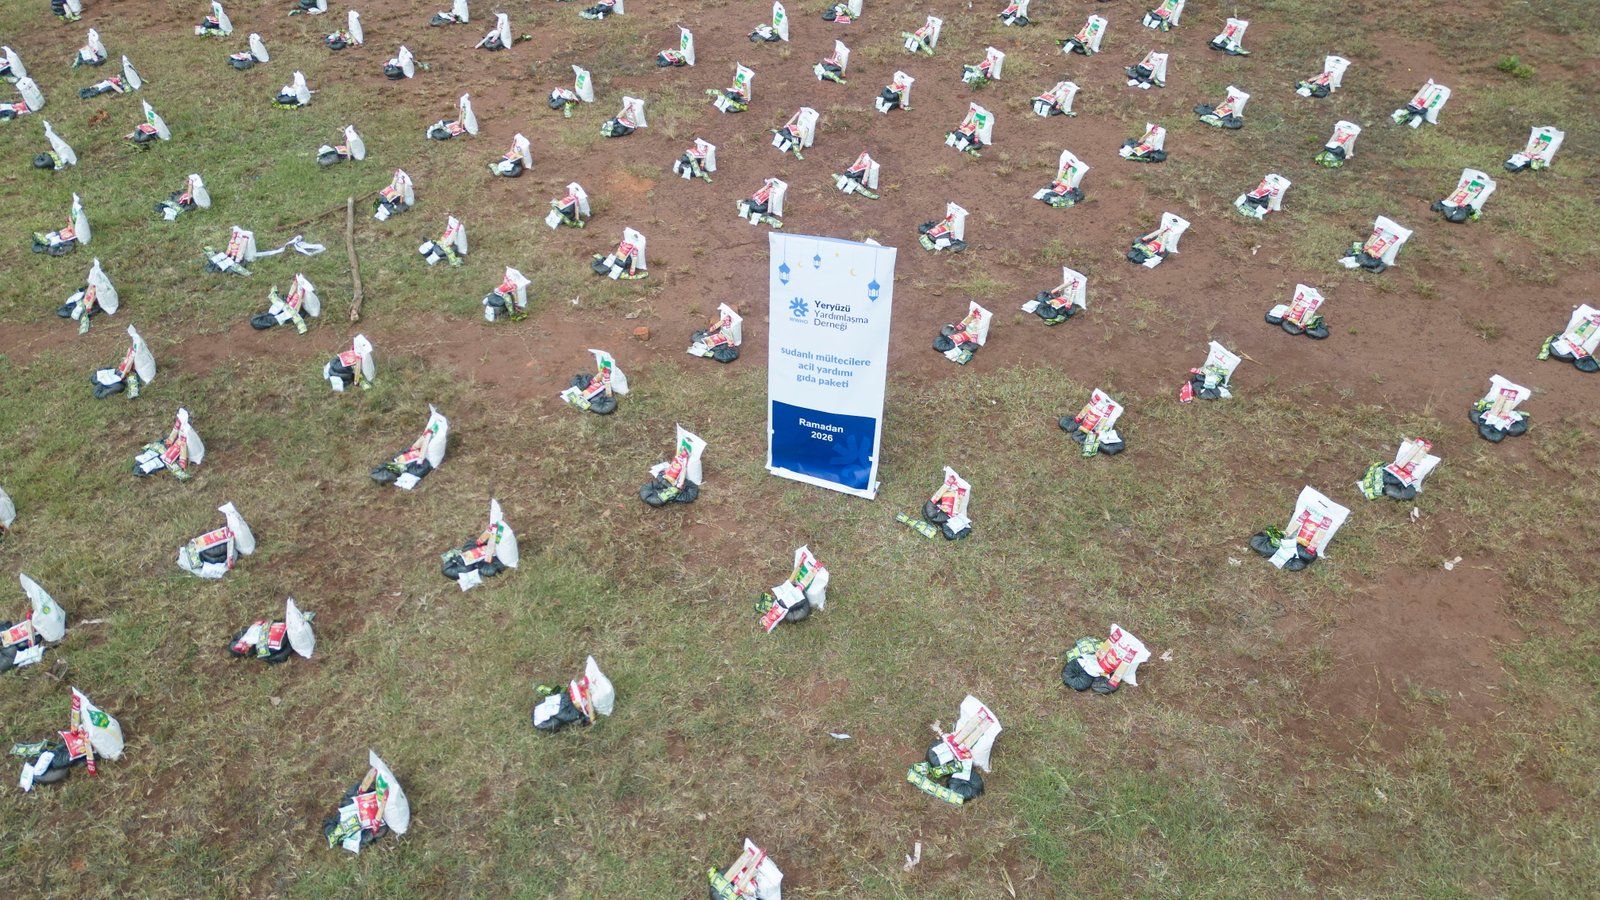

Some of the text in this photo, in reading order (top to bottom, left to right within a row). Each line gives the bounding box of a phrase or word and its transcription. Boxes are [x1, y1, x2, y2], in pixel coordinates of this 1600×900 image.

[814, 300, 851, 312] Yeryüzü
[814, 310, 869, 324] Yardımlaşma
[814, 318, 847, 331] Derneği
[781, 347, 871, 366] sudanlı mültecilere
[798, 362, 853, 377] acil yardımı
[796, 374, 849, 388] gıda paketi
[799, 417, 844, 433] Ramadan
[811, 430, 833, 442] 2026
